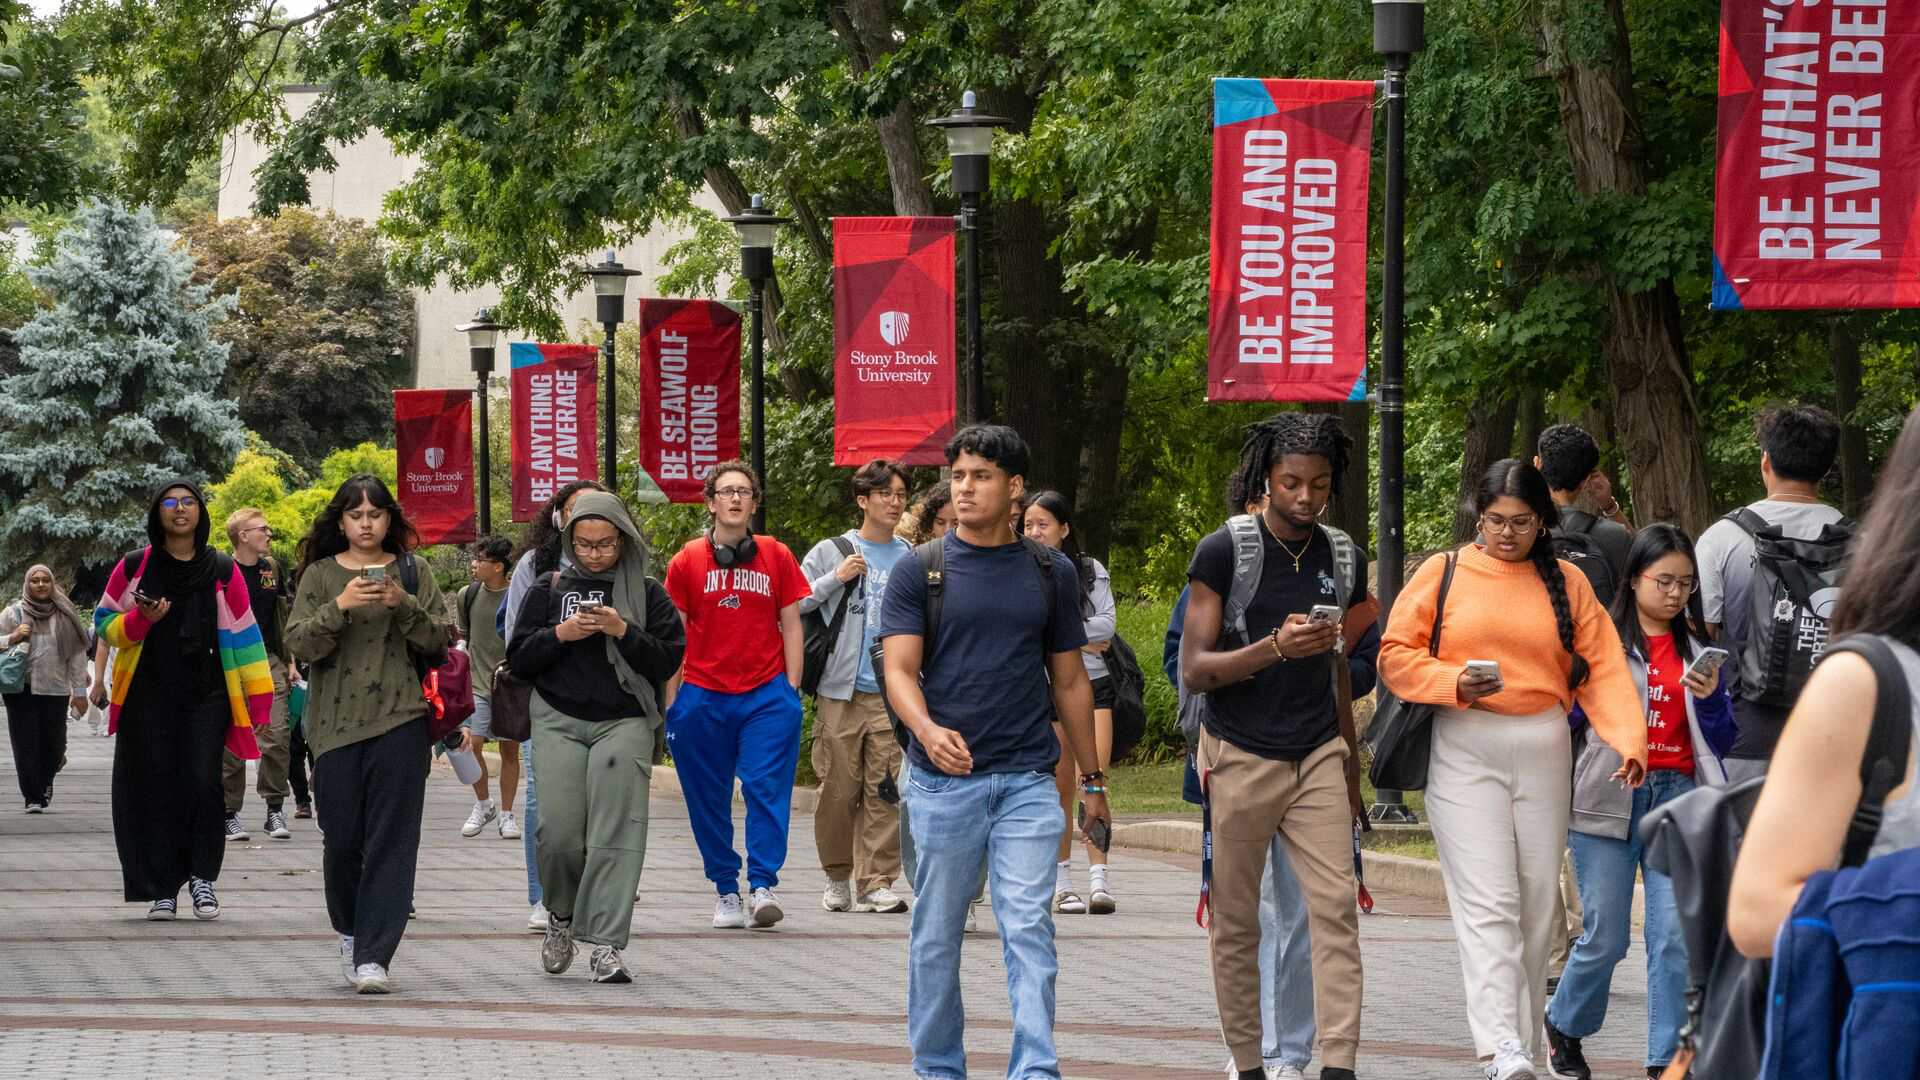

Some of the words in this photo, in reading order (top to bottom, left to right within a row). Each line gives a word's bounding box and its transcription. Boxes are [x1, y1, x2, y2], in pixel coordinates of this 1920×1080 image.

[1829, 0, 1887, 73] BE
[1760, 0, 1820, 179] WHAT'
[1242, 129, 1288, 213] AND
[1824, 93, 1882, 260] NEVER
[1290, 158, 1338, 364] IMPROVED
[1759, 196, 1814, 259] BE
[1239, 225, 1285, 304] YOU
[850, 350, 892, 368] Stony
[895, 350, 938, 365] Brook
[1239, 314, 1283, 364] BE
[660, 328, 688, 443] SEAWOLF
[858, 368, 932, 385] University
[530, 374, 553, 472] ANYTHING
[555, 370, 578, 459] AVERAGE
[690, 385, 718, 480] STRONG
[406, 472, 433, 483] Stony
[435, 471, 463, 481] Brook
[411, 482, 459, 493] University
[531, 478, 554, 502] BE
[660, 449, 688, 480] BE
[732, 568, 771, 598] BROOK
[1797, 617, 1815, 651] THE
